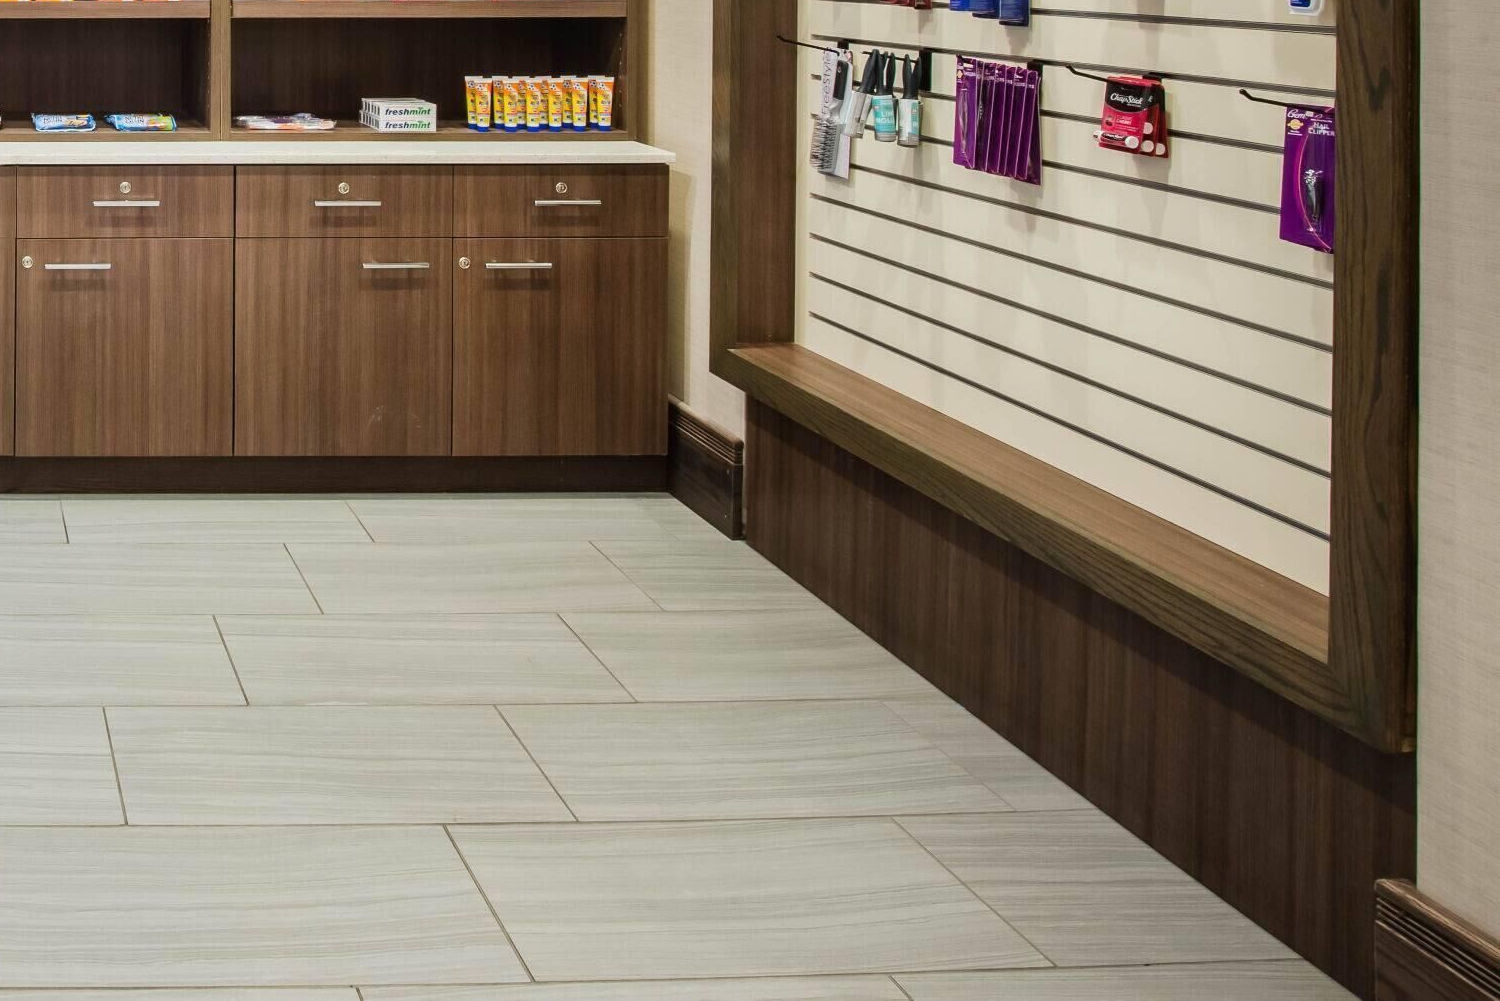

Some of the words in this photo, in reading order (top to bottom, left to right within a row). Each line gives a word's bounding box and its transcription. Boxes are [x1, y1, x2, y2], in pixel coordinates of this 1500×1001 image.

[1110, 93, 1143, 105] ChapStick
[385, 107, 431, 116] freshmint
[385, 120, 431, 129] freshmint
